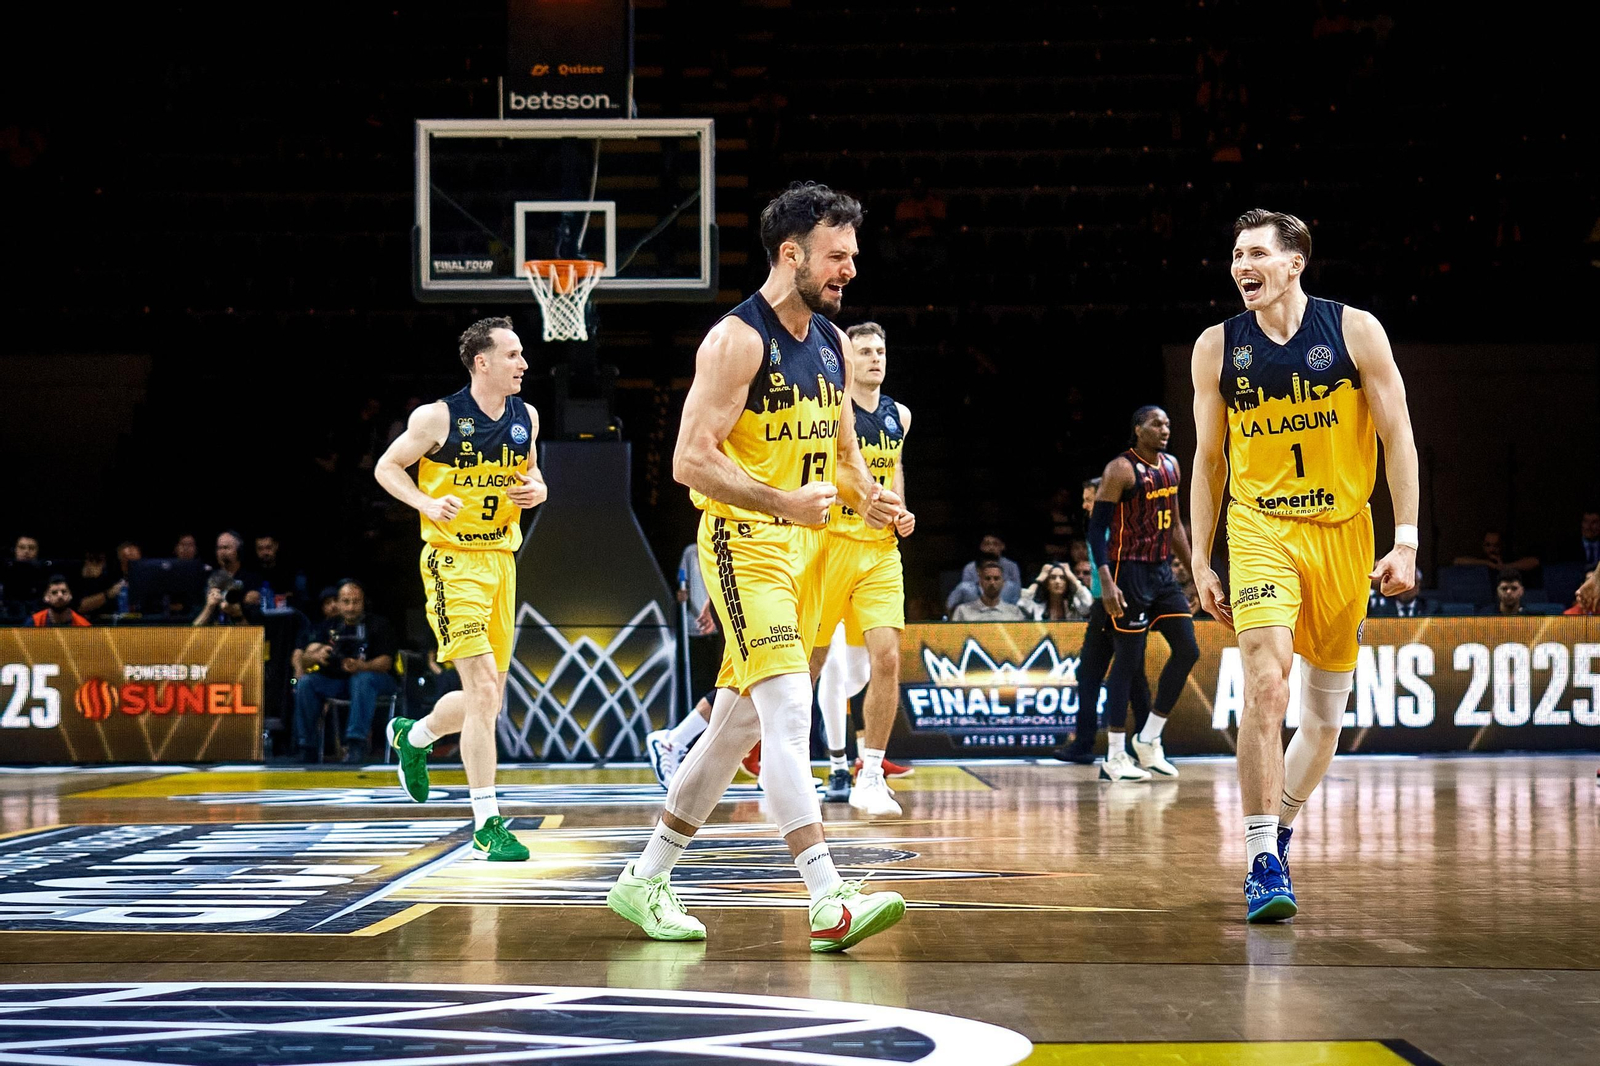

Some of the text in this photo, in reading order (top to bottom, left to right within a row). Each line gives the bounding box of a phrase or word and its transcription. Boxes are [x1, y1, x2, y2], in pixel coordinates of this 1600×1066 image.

[509, 91, 610, 110] betsson
[434, 260, 493, 270] FINAL FOUR
[766, 422, 793, 441] LA
[1241, 409, 1339, 437] LA LAGUNA
[801, 451, 827, 487] 13
[1290, 443, 1305, 478] 1
[453, 473, 474, 487] LA
[482, 495, 499, 521] 9
[1256, 488, 1335, 509] tenerife
[1157, 509, 1172, 530] 15
[750, 632, 794, 648] Canarias
[770, 624, 793, 636] Islas
[124, 664, 208, 681] POWERED BY
[0, 663, 61, 729] 25
[1212, 642, 1600, 730] ANS 2025
[121, 683, 258, 715] SUNEL
[908, 687, 1010, 716] FINAL
